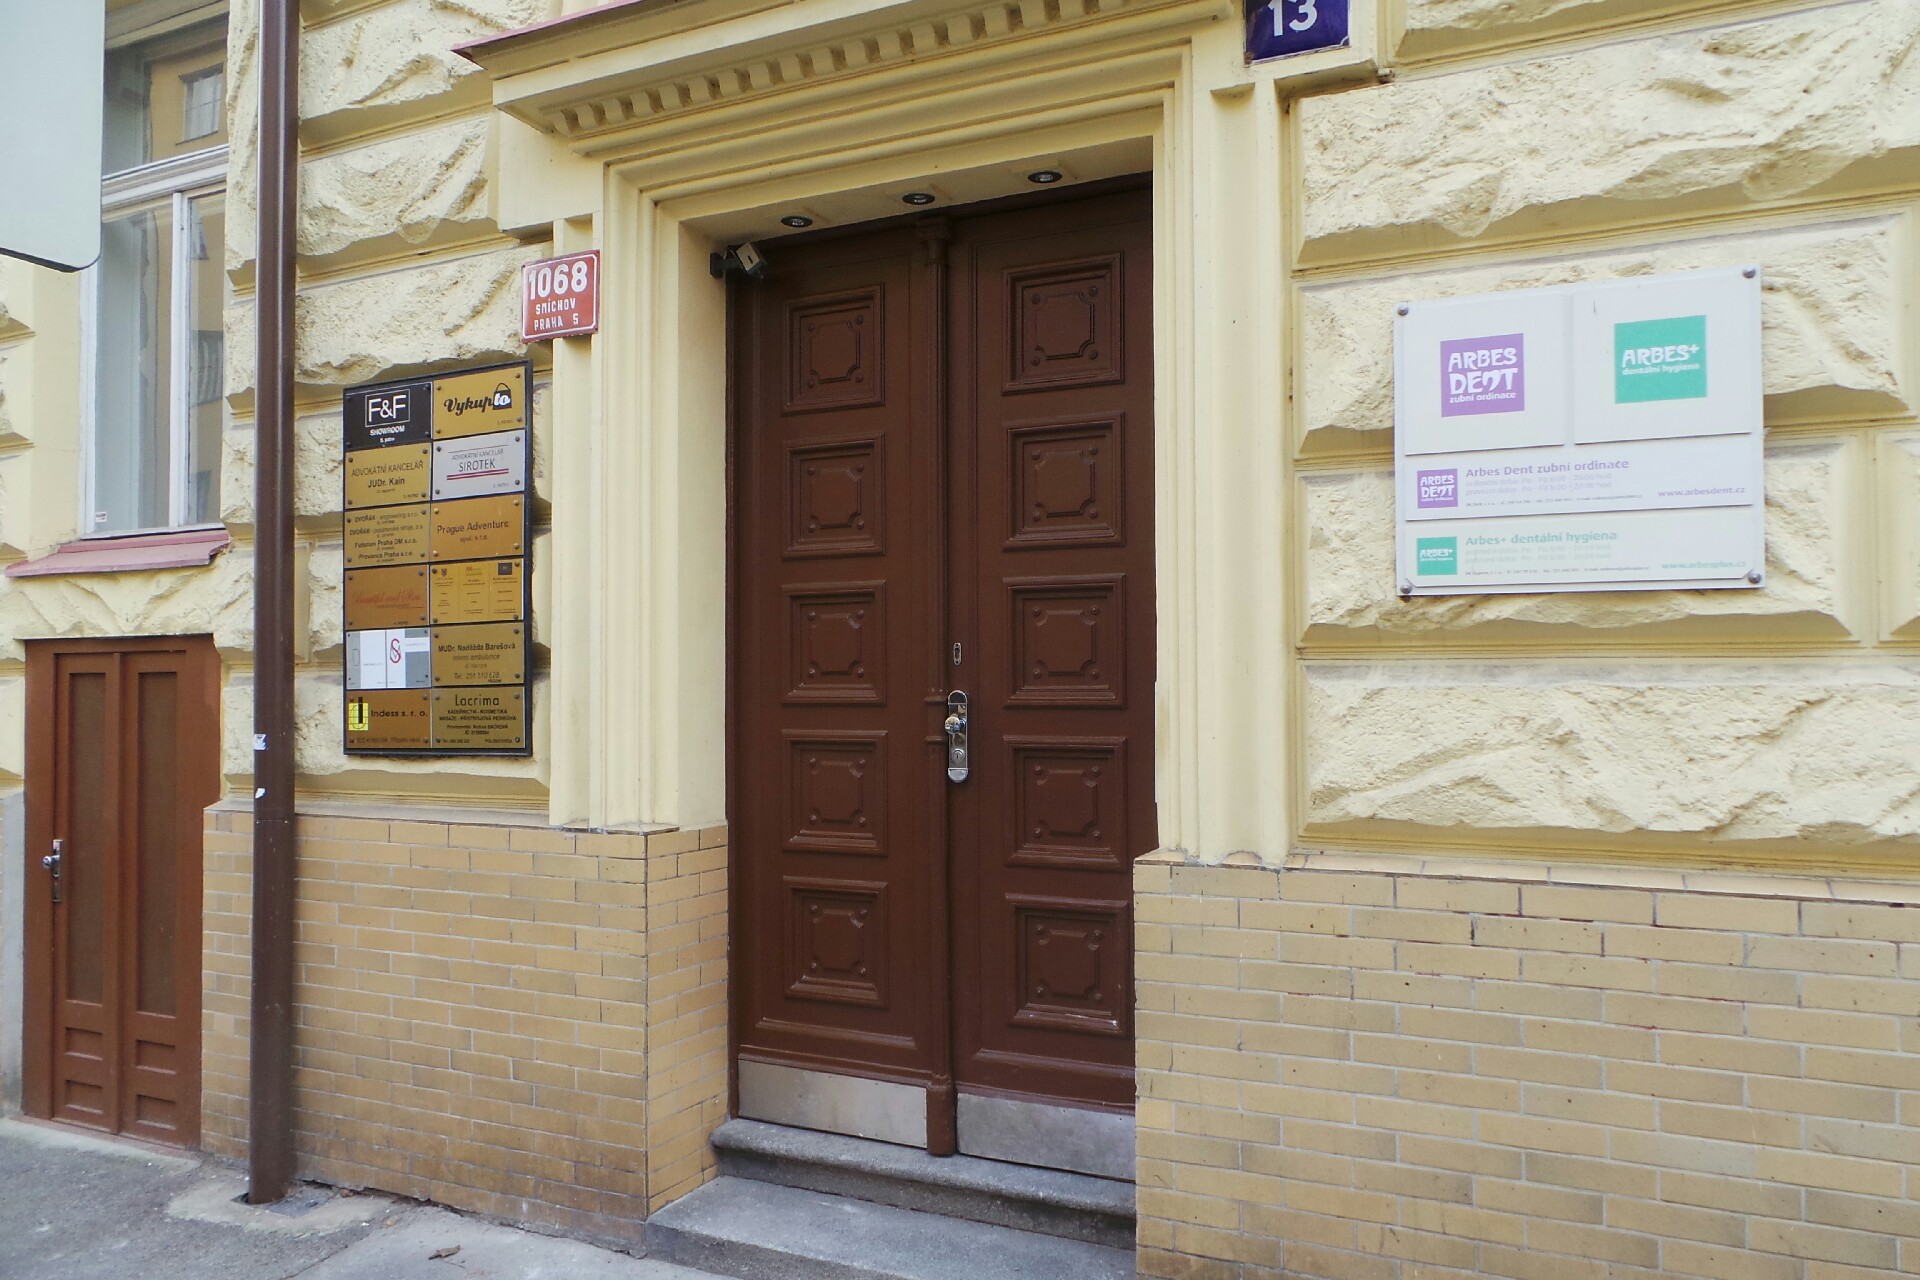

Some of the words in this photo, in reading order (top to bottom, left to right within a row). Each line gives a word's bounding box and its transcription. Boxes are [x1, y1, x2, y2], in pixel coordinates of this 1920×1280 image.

[1268, 0, 1318, 36] 13
[528, 260, 588, 300] 1068
[534, 315, 563, 331] PRAHA
[572, 313, 579, 325] 5
[1448, 347, 1517, 372] ARBES
[1622, 344, 1700, 368] ARBES+
[1622, 365, 1660, 375] dentální
[1662, 363, 1700, 373] hygiena
[1449, 367, 1519, 395] DENT
[444, 393, 511, 416] Vykupto
[1449, 394, 1474, 404] zubní
[1476, 392, 1517, 401] ordinace
[368, 394, 407, 423] F&F
[370, 425, 405, 436] SHOWROOM
[452, 451, 478, 461] ADVOKÁTNÍ
[351, 463, 388, 477] ADVOKÁTNÍ
[388, 459, 424, 473] KANCELÁŘ
[458, 458, 496, 472] SIROTEK
[1466, 467, 1500, 477] Arbes
[1504, 465, 1533, 475] Dent
[1574, 460, 1629, 471] ordinace
[368, 479, 387, 488] JUDr.
[388, 476, 405, 486] Kain
[1420, 474, 1454, 486] ARBES
[1658, 487, 1745, 497] www.arbesdent.cz
[437, 525, 465, 536] Prague
[466, 520, 509, 531] Adventure
[1465, 536, 1506, 545] Arbes+
[1566, 531, 1617, 544] hygiena
[455, 693, 500, 706] Lacrima
[370, 709, 399, 717] Indess
